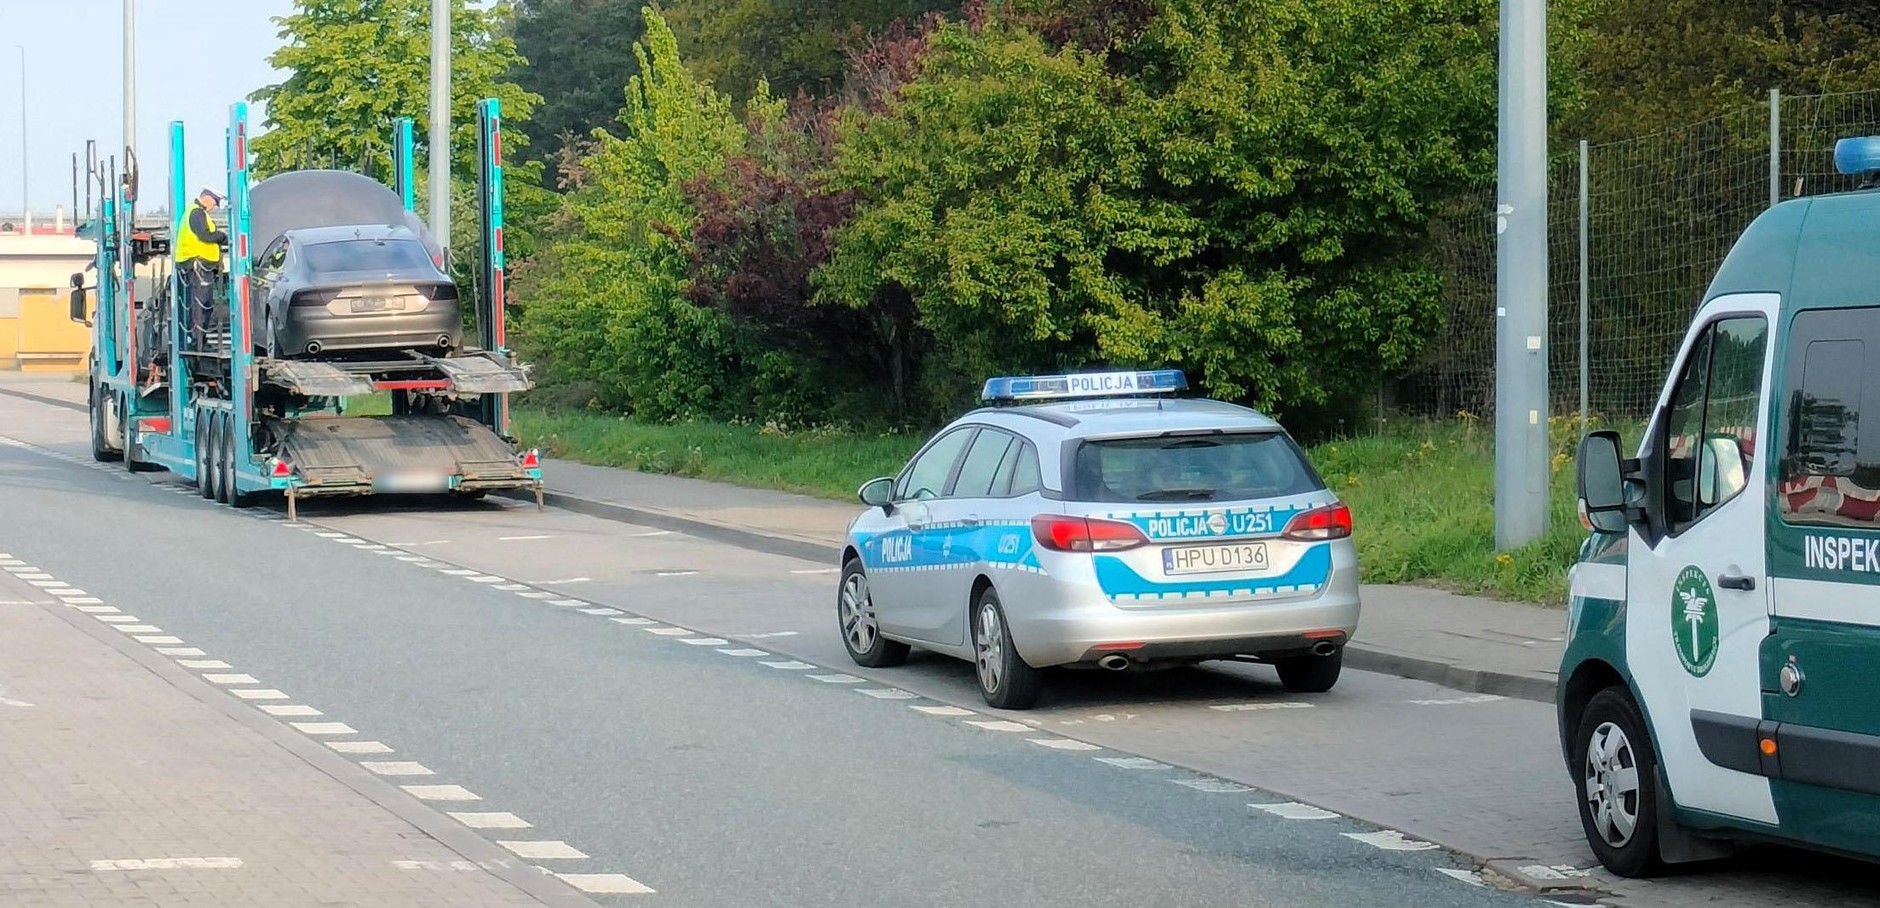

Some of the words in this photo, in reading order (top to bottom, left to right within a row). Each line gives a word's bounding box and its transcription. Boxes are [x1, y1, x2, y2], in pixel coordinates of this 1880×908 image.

[1071, 376, 1133, 391] POLICJA
[1149, 516, 1208, 537] POLICJA
[1233, 513, 1273, 533] U251
[881, 535, 912, 563] POLICJA
[1176, 548, 1214, 568] HPU
[1221, 546, 1264, 566] D136
[1804, 535, 1880, 572] INSPEK
